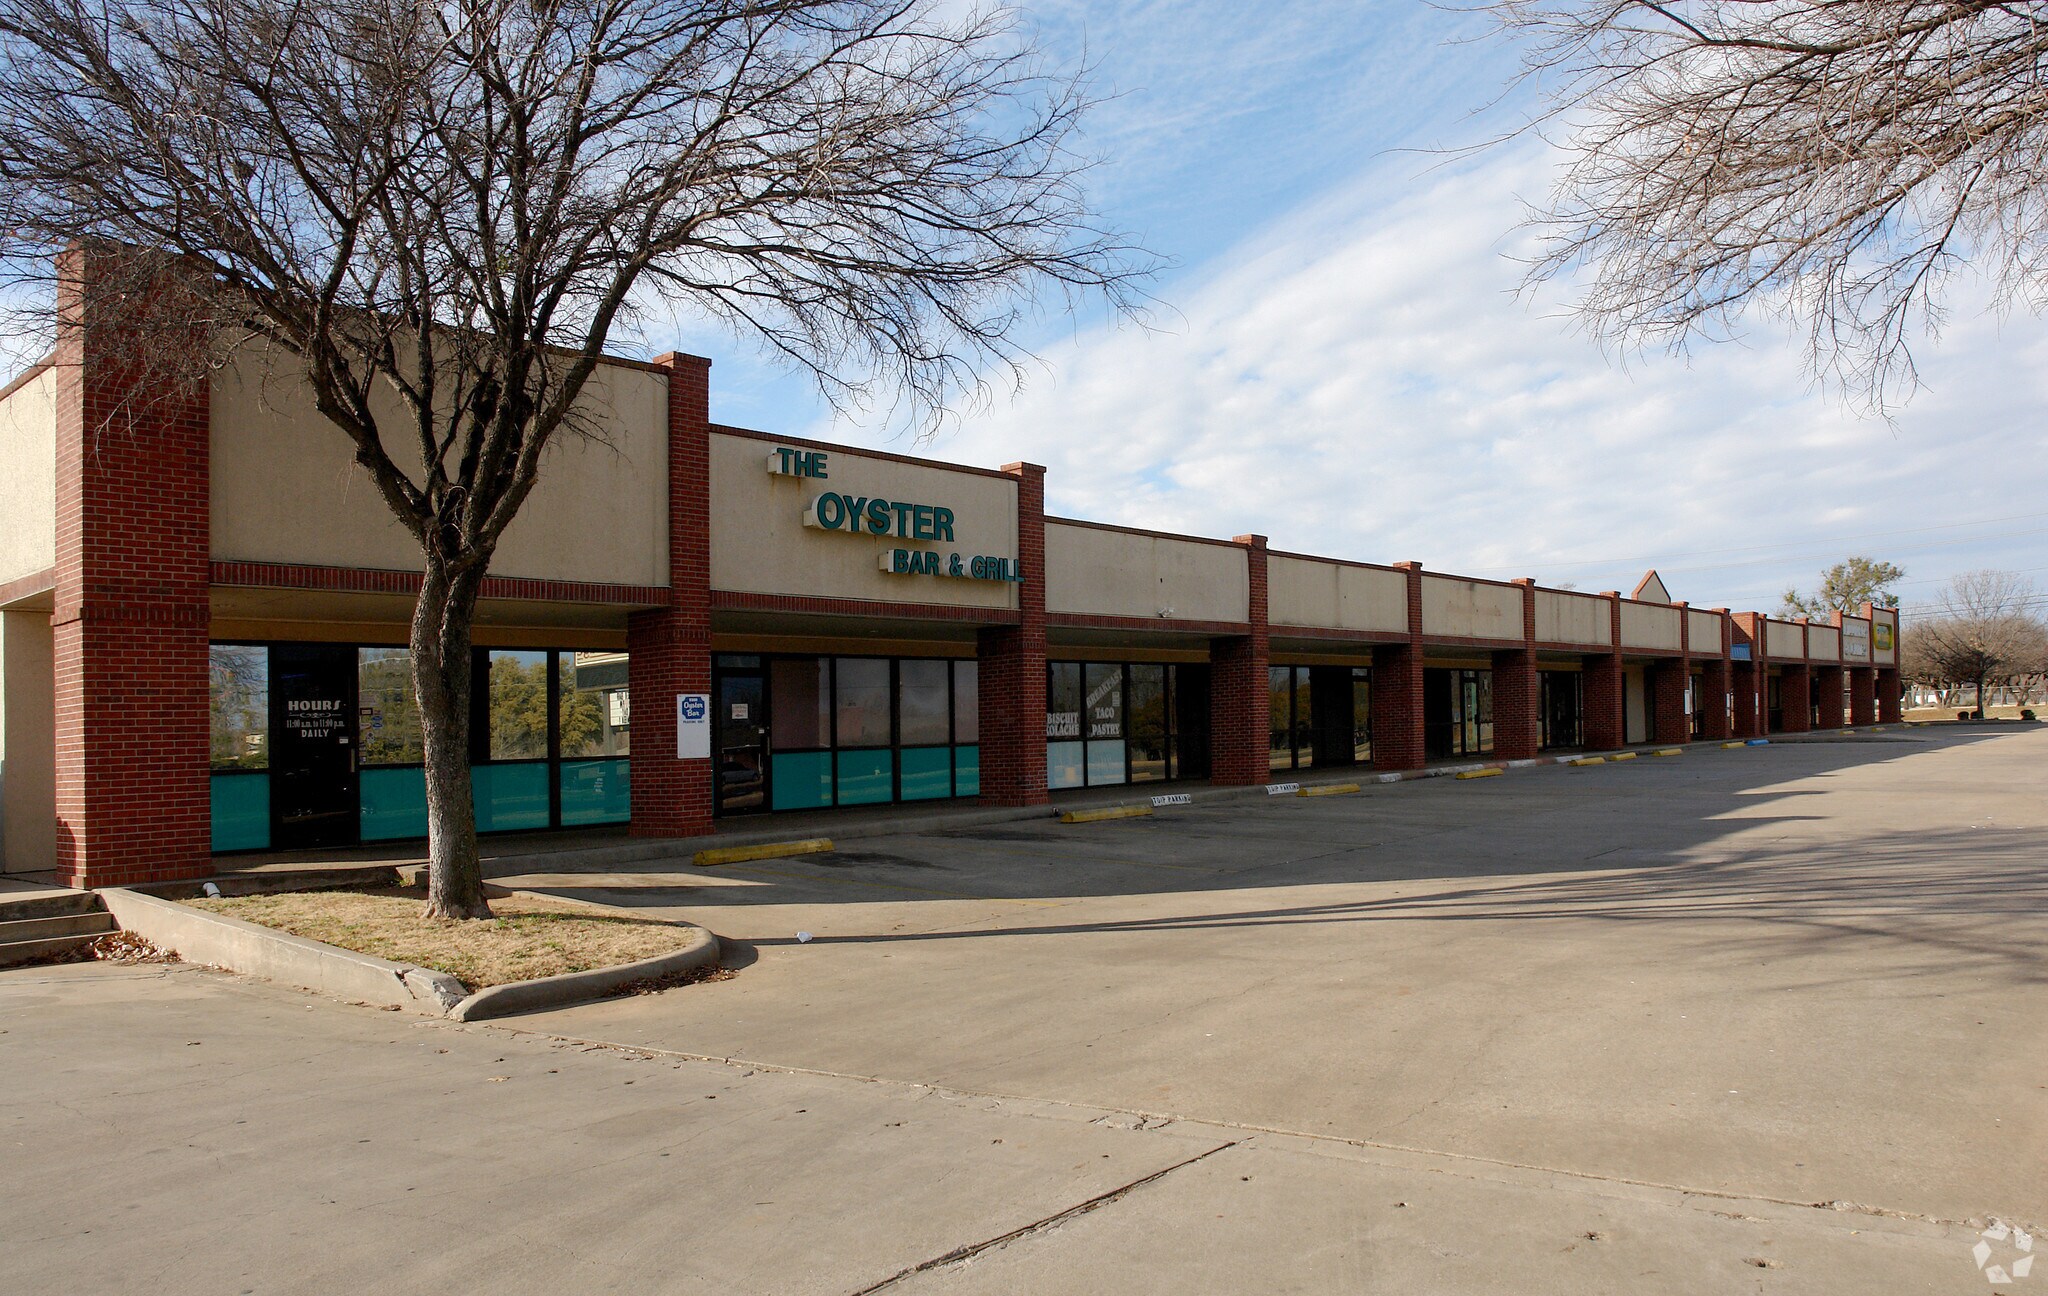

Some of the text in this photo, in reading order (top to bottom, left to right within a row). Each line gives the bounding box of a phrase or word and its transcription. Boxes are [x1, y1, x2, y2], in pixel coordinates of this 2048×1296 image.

[777, 447, 828, 479] THE
[816, 492, 955, 542] OYSTER
[893, 549, 1025, 582] BAR & GRILL
[288, 700, 341, 711] HOURS
[1047, 712, 1079, 724] BISCUIT
[1095, 707, 1115, 719] TACO
[301, 729, 329, 737] DAILY
[1092, 723, 1120, 736] PASTRY
